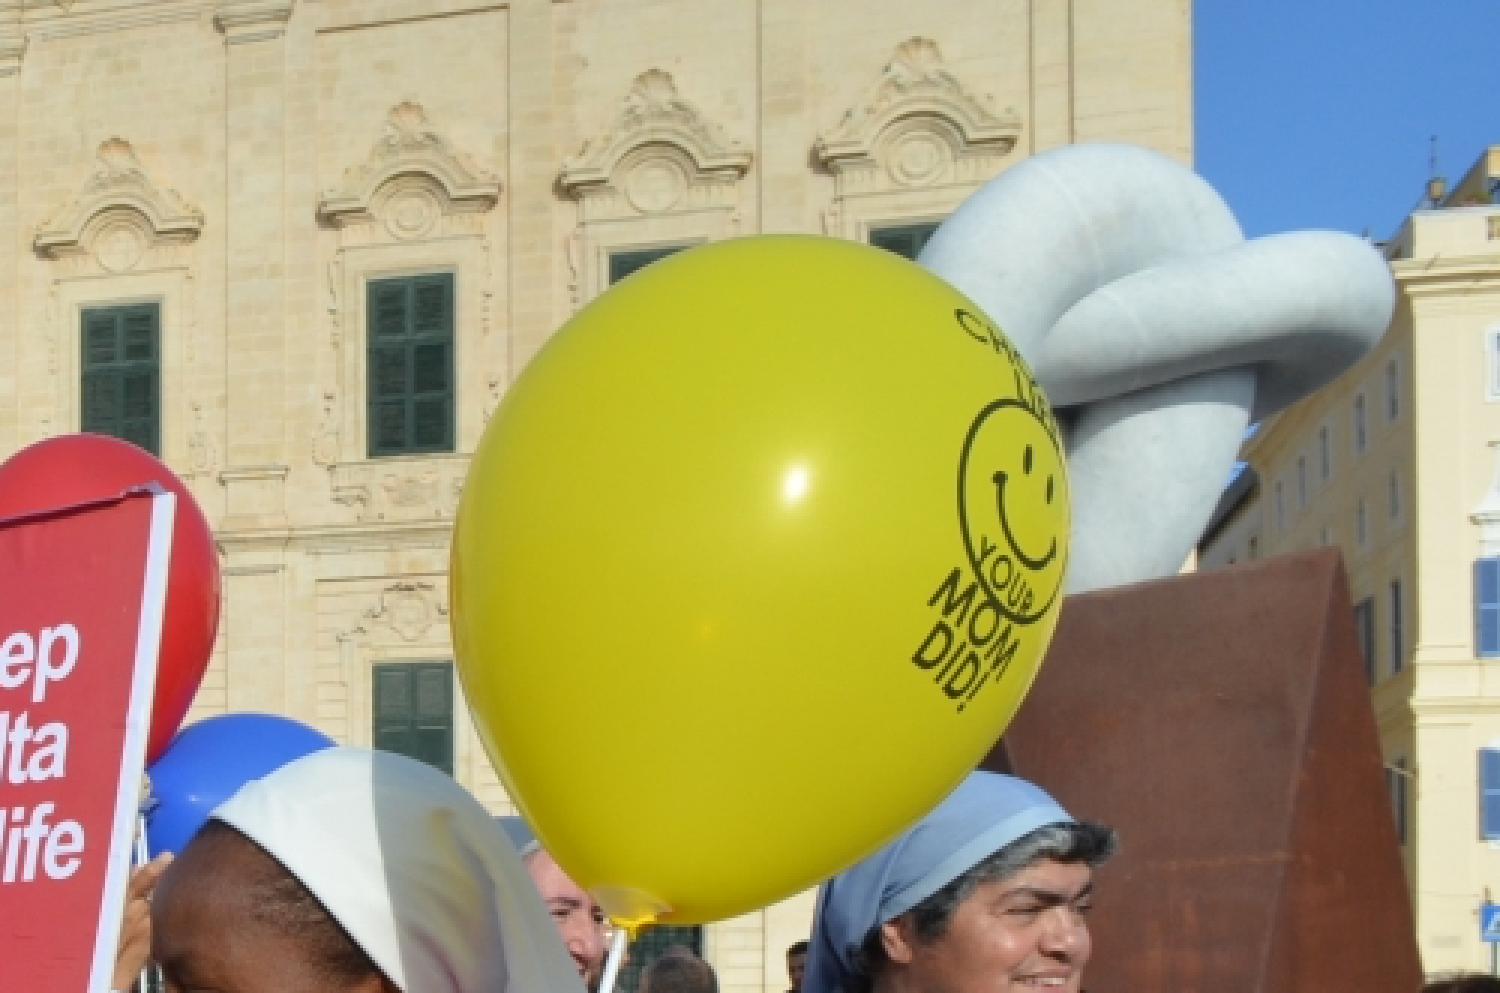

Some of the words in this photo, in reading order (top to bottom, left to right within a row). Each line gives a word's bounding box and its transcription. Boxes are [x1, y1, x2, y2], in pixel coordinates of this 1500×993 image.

[974, 534, 1034, 615] YOUR
[911, 620, 989, 713] DID!
[928, 567, 1019, 683] MOM
